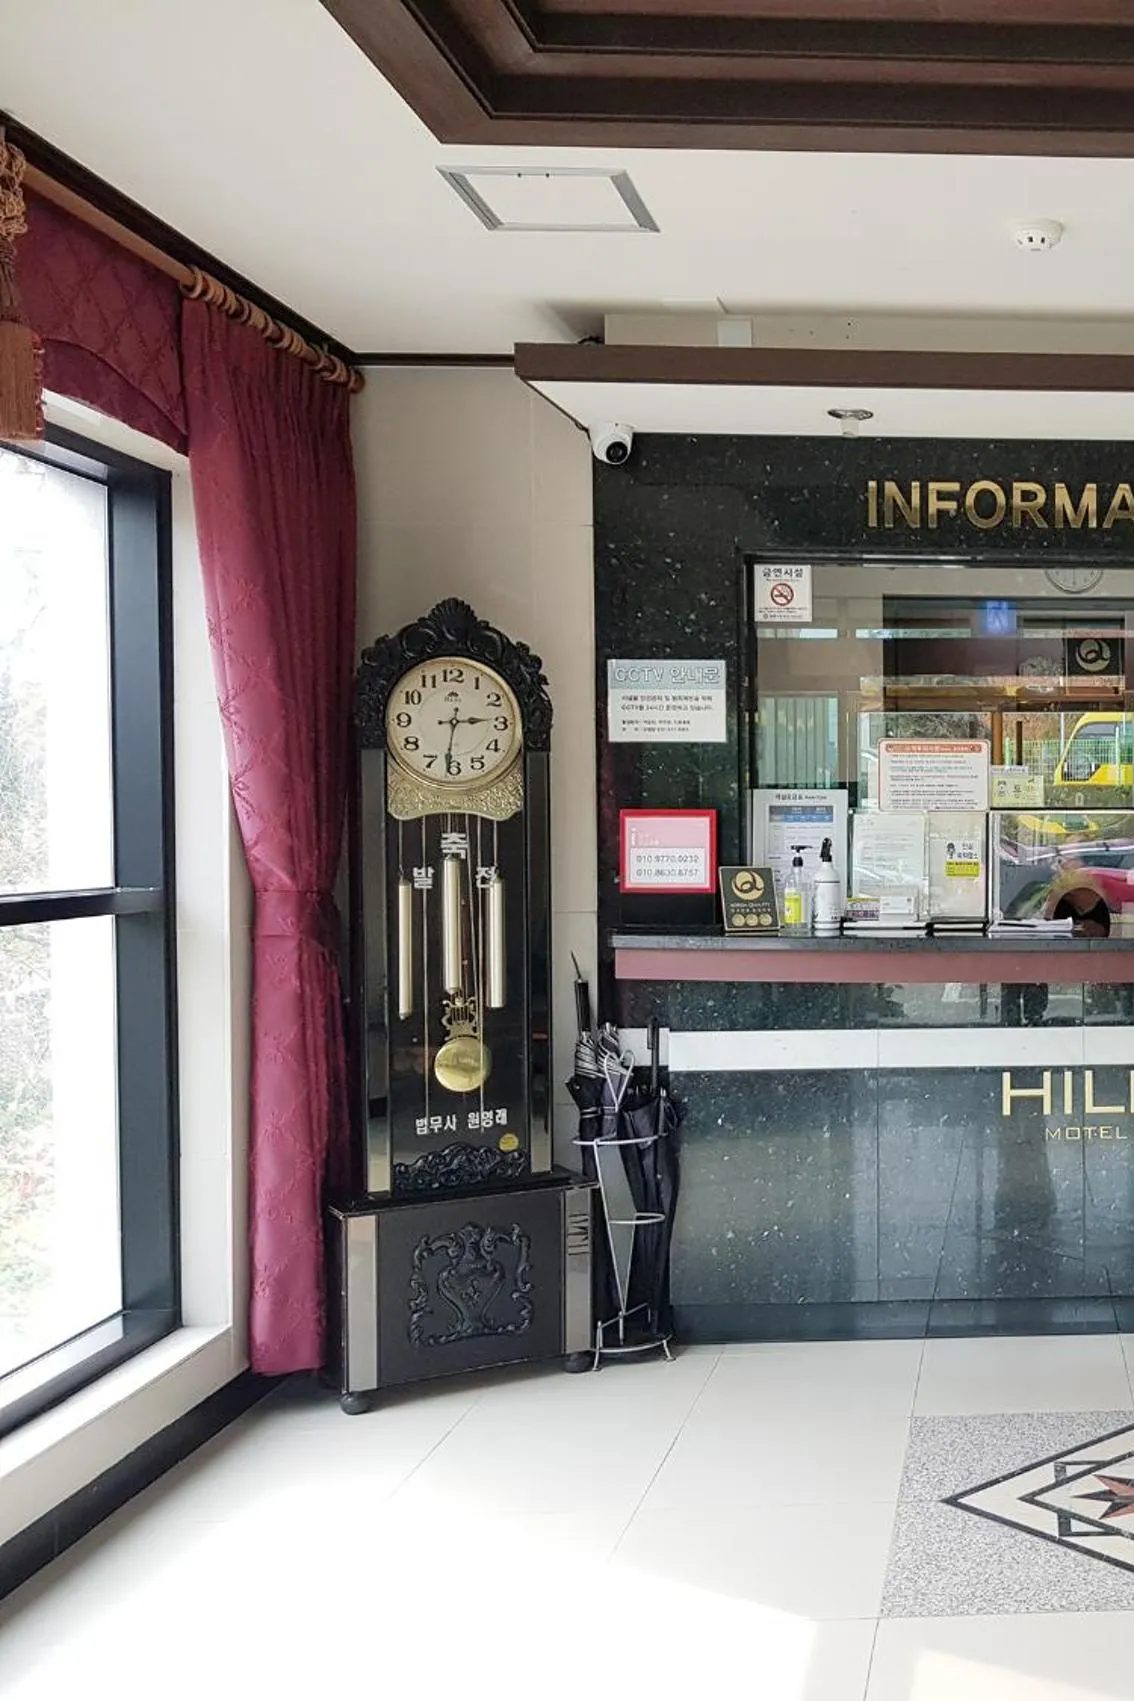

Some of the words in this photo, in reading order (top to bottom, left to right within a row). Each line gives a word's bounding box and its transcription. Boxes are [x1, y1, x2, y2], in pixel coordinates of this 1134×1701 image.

[762, 567, 803, 578] 금연시설
[421, 674, 437, 689] 11
[442, 668, 465, 684] 12
[474, 676, 480, 690] 1
[615, 666, 664, 683] CCTV
[669, 666, 721, 685] 안내문
[405, 689, 422, 706] 10
[486, 692, 502, 707] 2
[396, 712, 412, 728] 9
[493, 716, 508, 731] 3
[404, 735, 420, 751] 8
[486, 738, 500, 753] 4
[423, 753, 438, 769] 7
[448, 759, 462, 776] 6
[470, 754, 485, 770] 5
[441, 833, 467, 859] 축
[413, 866, 435, 889] 발
[415, 1114, 457, 1135] 법무사
[467, 1108, 508, 1129] 원영래
[1046, 1126, 1128, 1140] MOTEL
